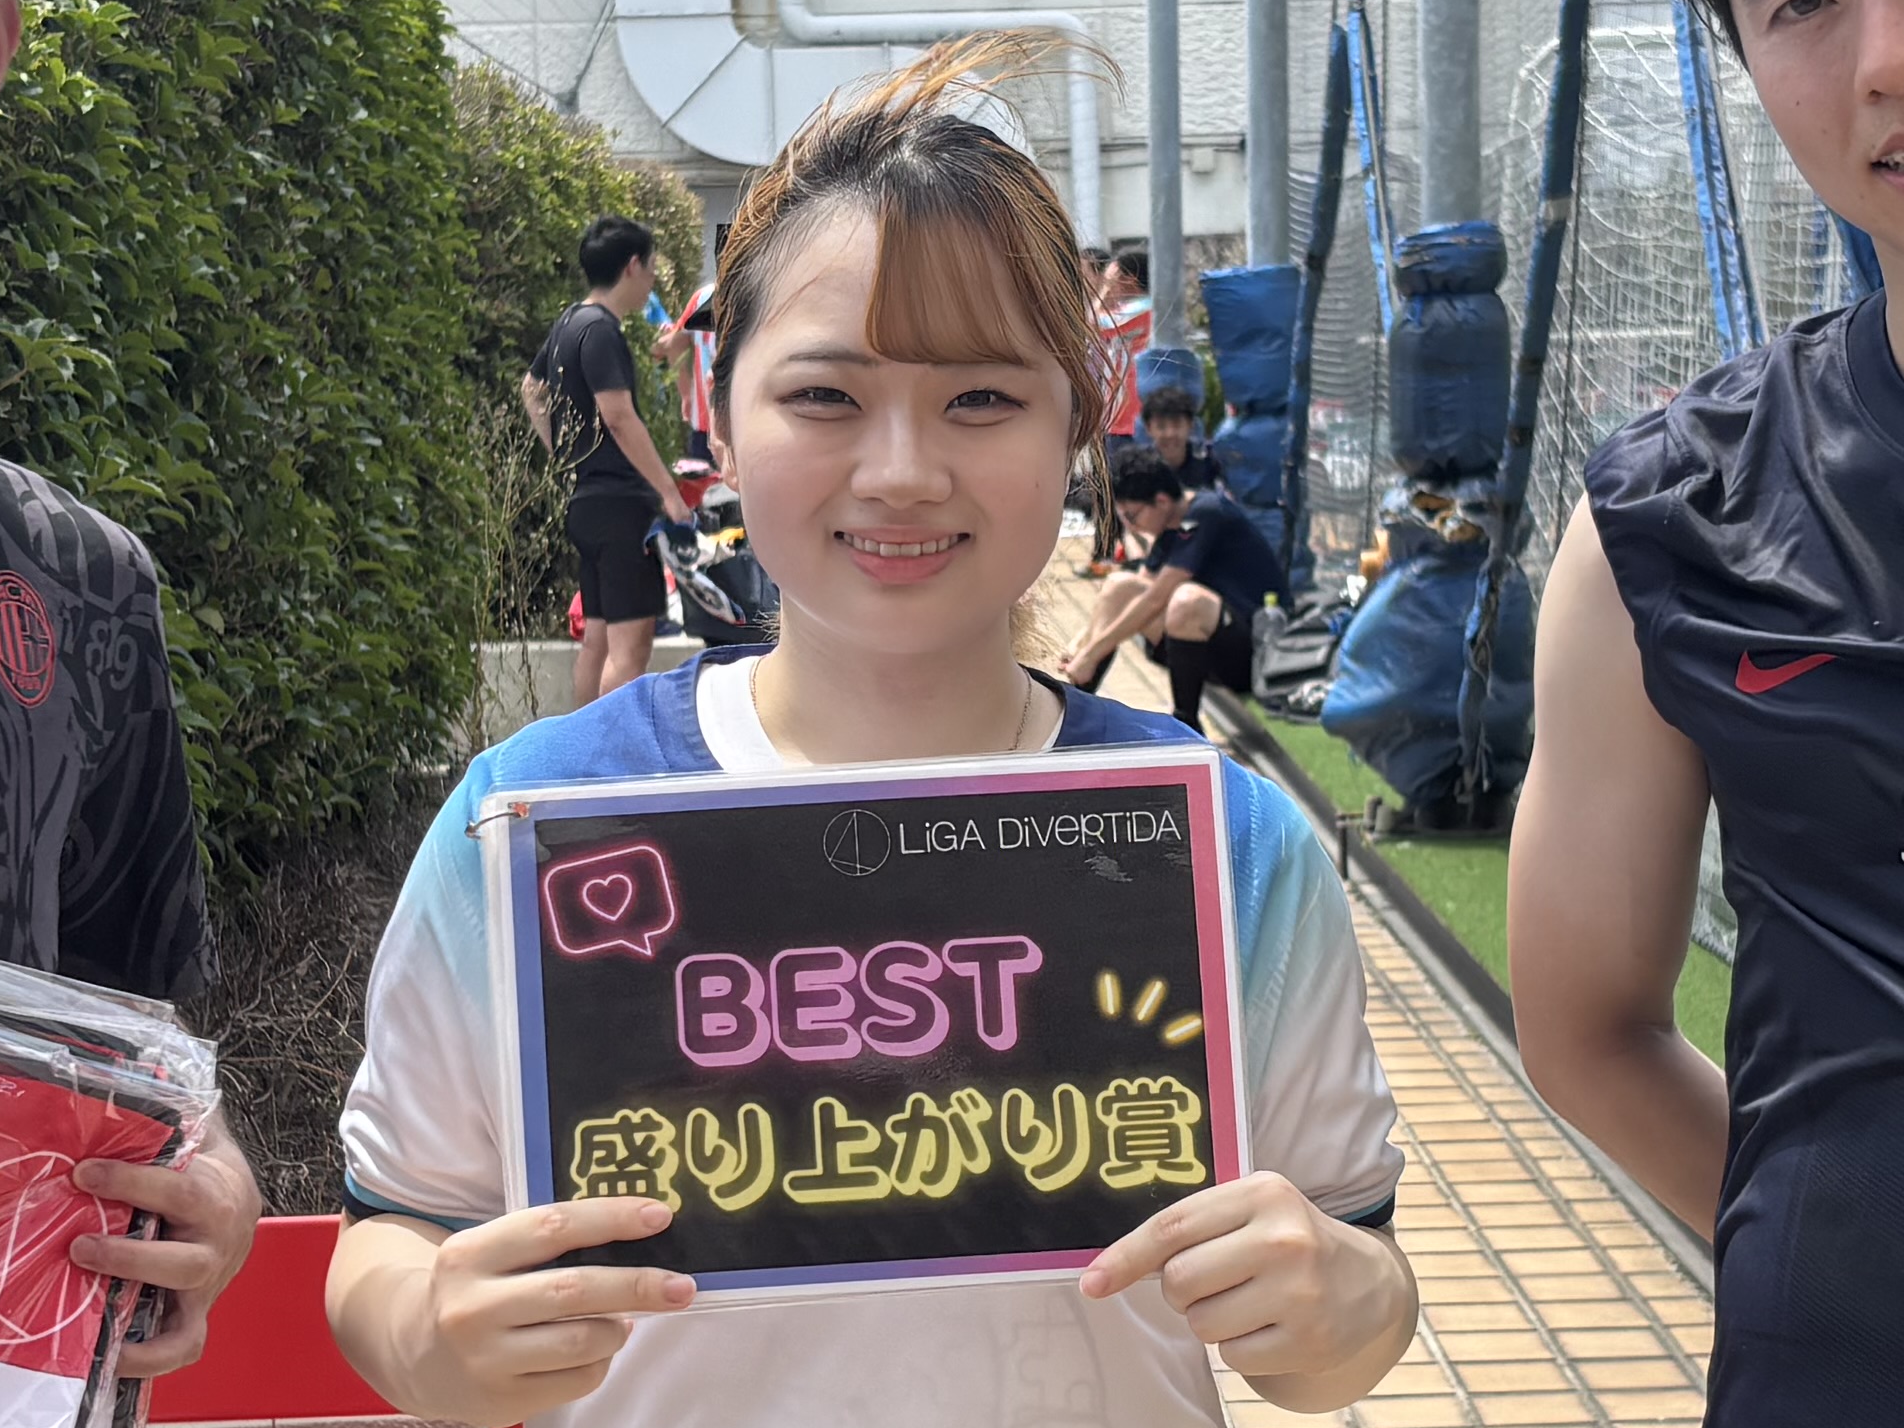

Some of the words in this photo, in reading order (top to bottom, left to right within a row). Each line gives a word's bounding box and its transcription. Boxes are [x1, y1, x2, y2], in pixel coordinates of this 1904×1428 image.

[675, 935, 1043, 1068] BEST
[570, 1076, 1206, 1213] 盛り上がり賞
